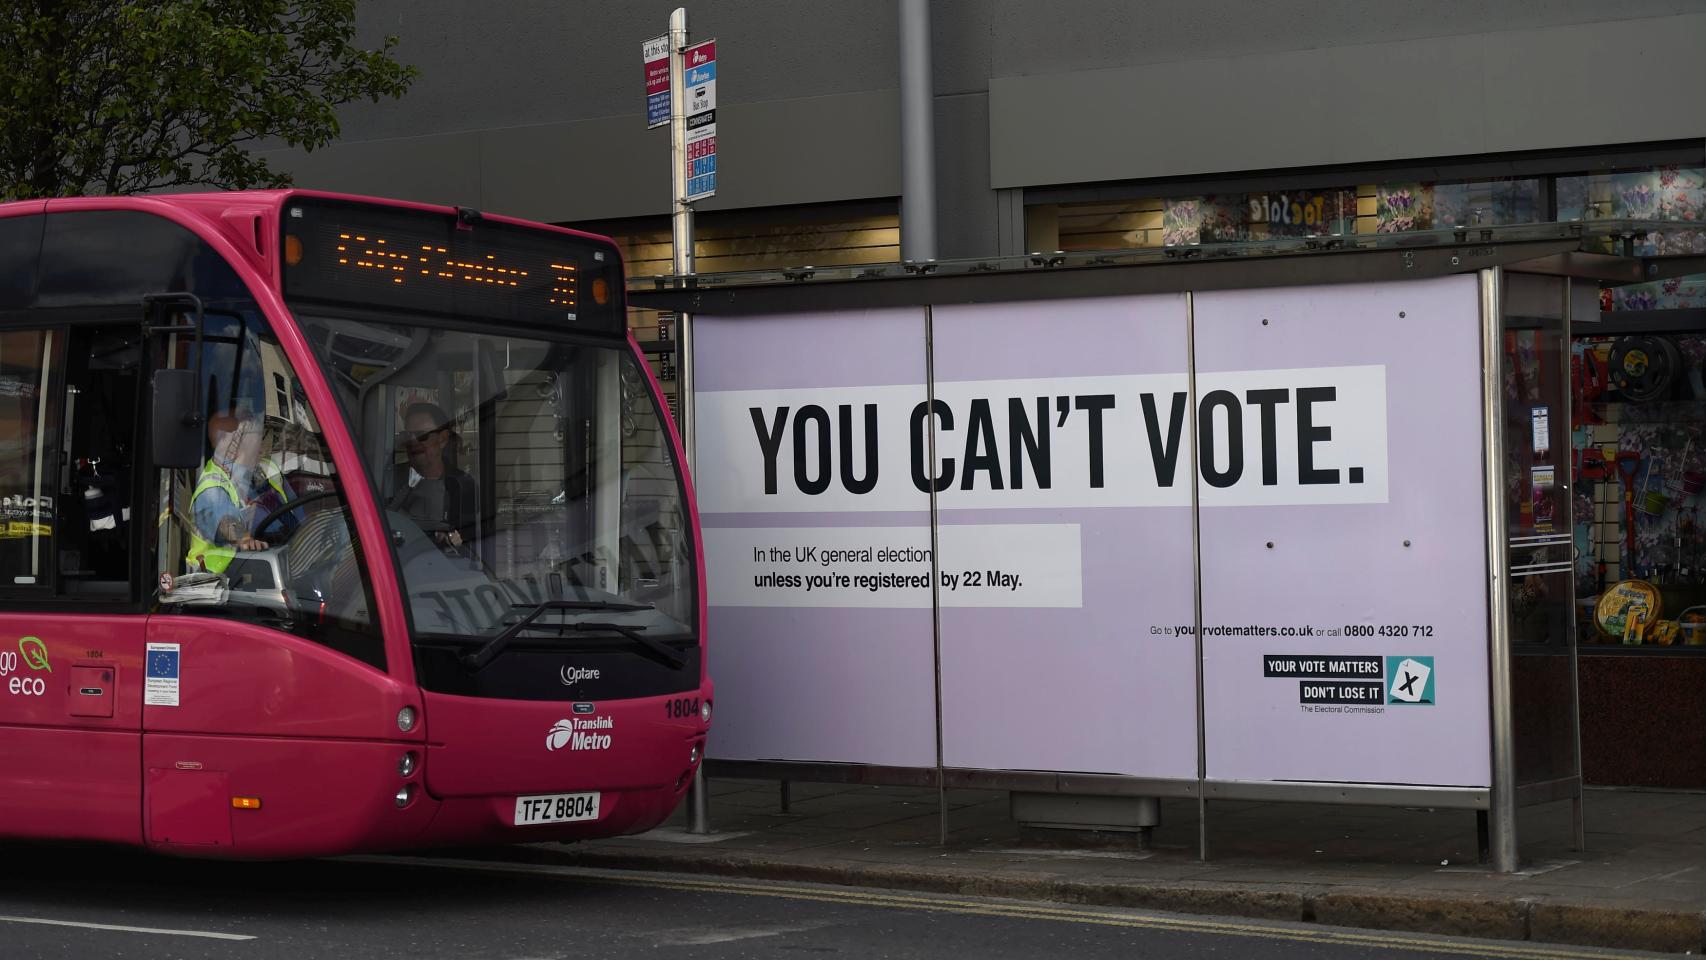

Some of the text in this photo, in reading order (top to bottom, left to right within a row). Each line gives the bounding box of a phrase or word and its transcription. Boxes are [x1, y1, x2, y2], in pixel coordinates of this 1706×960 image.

[651, 43, 660, 56] this
[692, 98, 709, 112] Bus Stop
[749, 385, 1365, 496] YOU CAN'T VOTE.
[753, 546, 933, 566] In the UK general election
[754, 570, 1023, 592] unless you're registered by 22 May.
[1150, 624, 1433, 640] Go to yourvotematters.co.uk or call 0800 4320 712
[566, 666, 600, 684] Optare
[1268, 660, 1379, 674] YOUR VOTE MATTERS
[9, 677, 46, 696] eco
[1303, 686, 1379, 700] DON'T LOSE IT
[665, 696, 700, 719] 1804
[1300, 705, 1385, 715] The Electoral Commission
[573, 716, 614, 731] Translink
[571, 732, 612, 751] Metro
[523, 795, 594, 822] TFZ 8804
